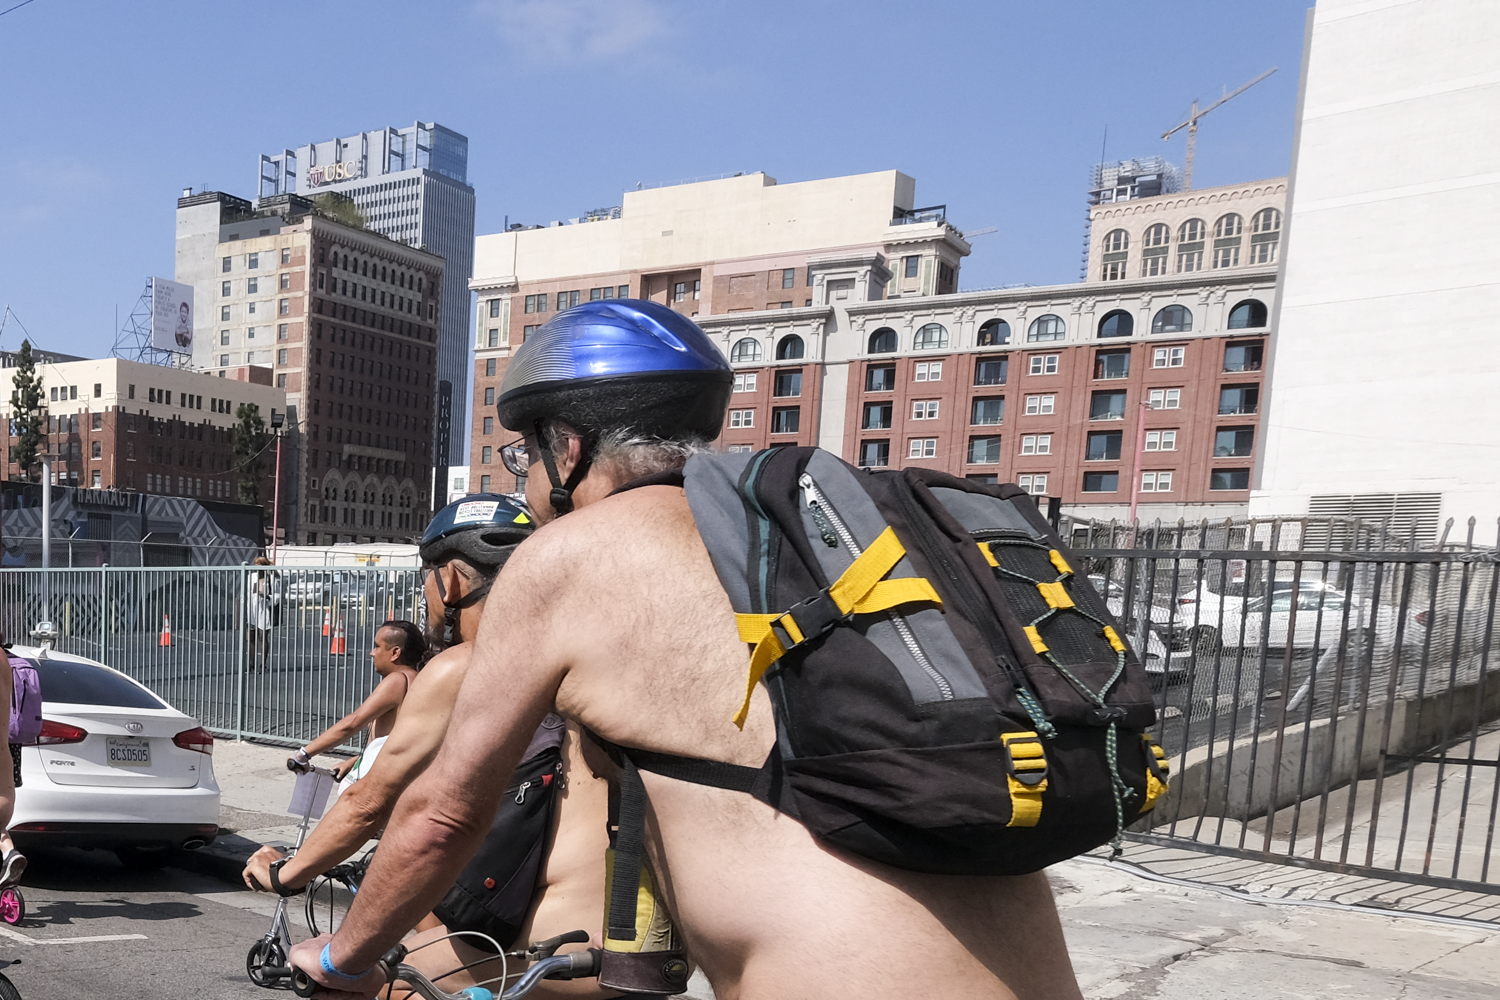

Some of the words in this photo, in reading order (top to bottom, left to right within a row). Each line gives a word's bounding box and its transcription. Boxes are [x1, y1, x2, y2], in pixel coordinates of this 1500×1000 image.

[325, 161, 357, 181] USC
[439, 395, 450, 467] PROPER
[130, 722, 142, 730] KIA
[110, 748, 148, 762] 8CSD505
[50, 759, 75, 767] FORTE
